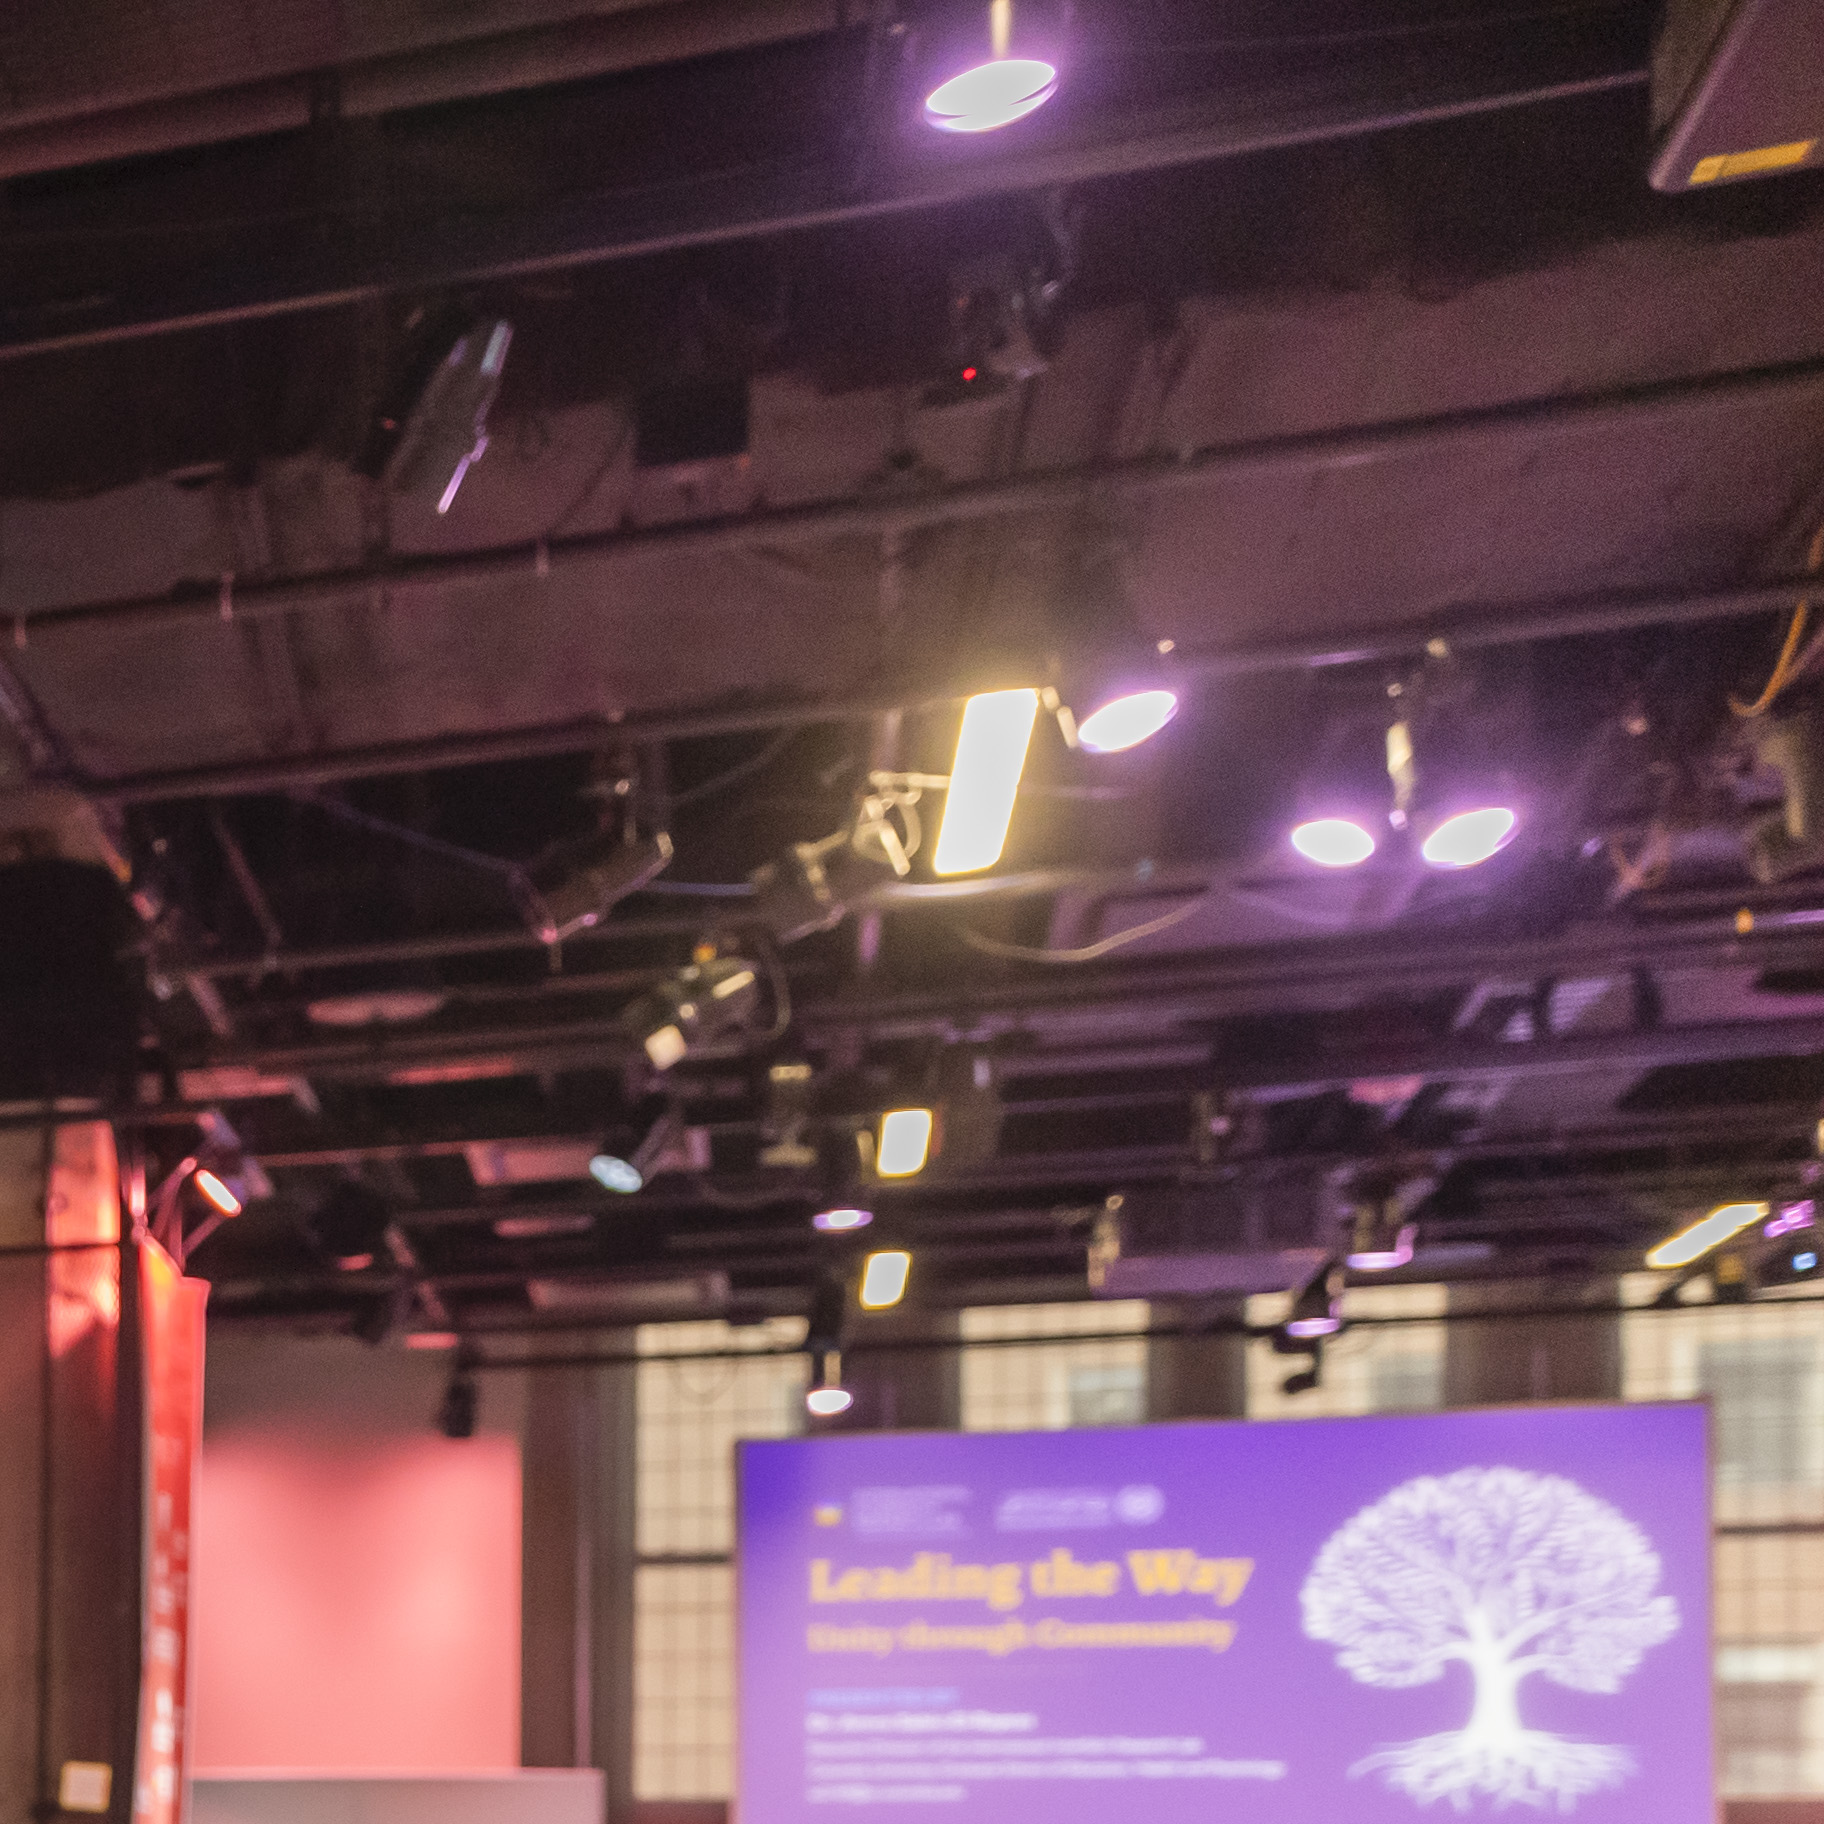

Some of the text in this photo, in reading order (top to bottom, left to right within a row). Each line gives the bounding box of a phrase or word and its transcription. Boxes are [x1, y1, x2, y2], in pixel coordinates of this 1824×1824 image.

[807, 1546, 1256, 1612] Leading the Way
